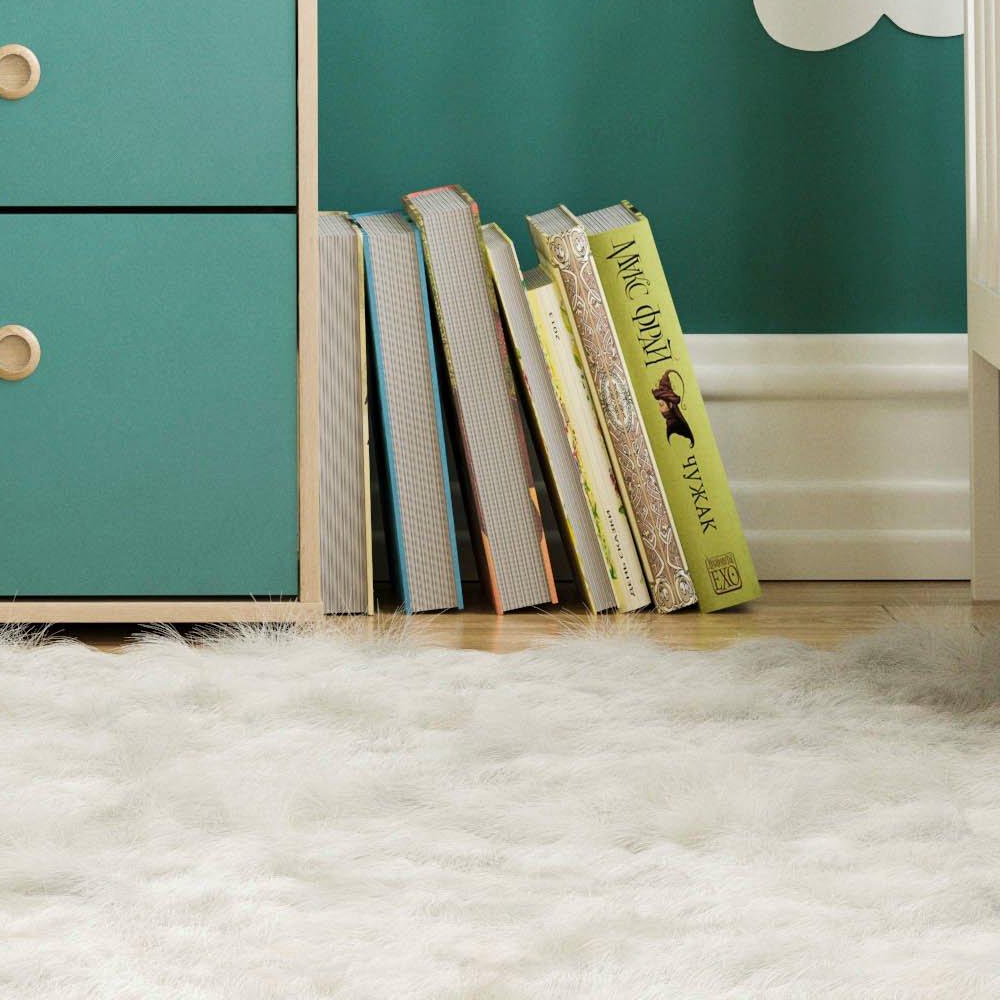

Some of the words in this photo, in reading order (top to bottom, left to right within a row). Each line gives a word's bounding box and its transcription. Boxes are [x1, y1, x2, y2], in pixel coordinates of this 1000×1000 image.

[606, 235, 650, 300] МАКС
[632, 304, 673, 368] ФРАЙ
[683, 455, 717, 534] ЧУЖАК
